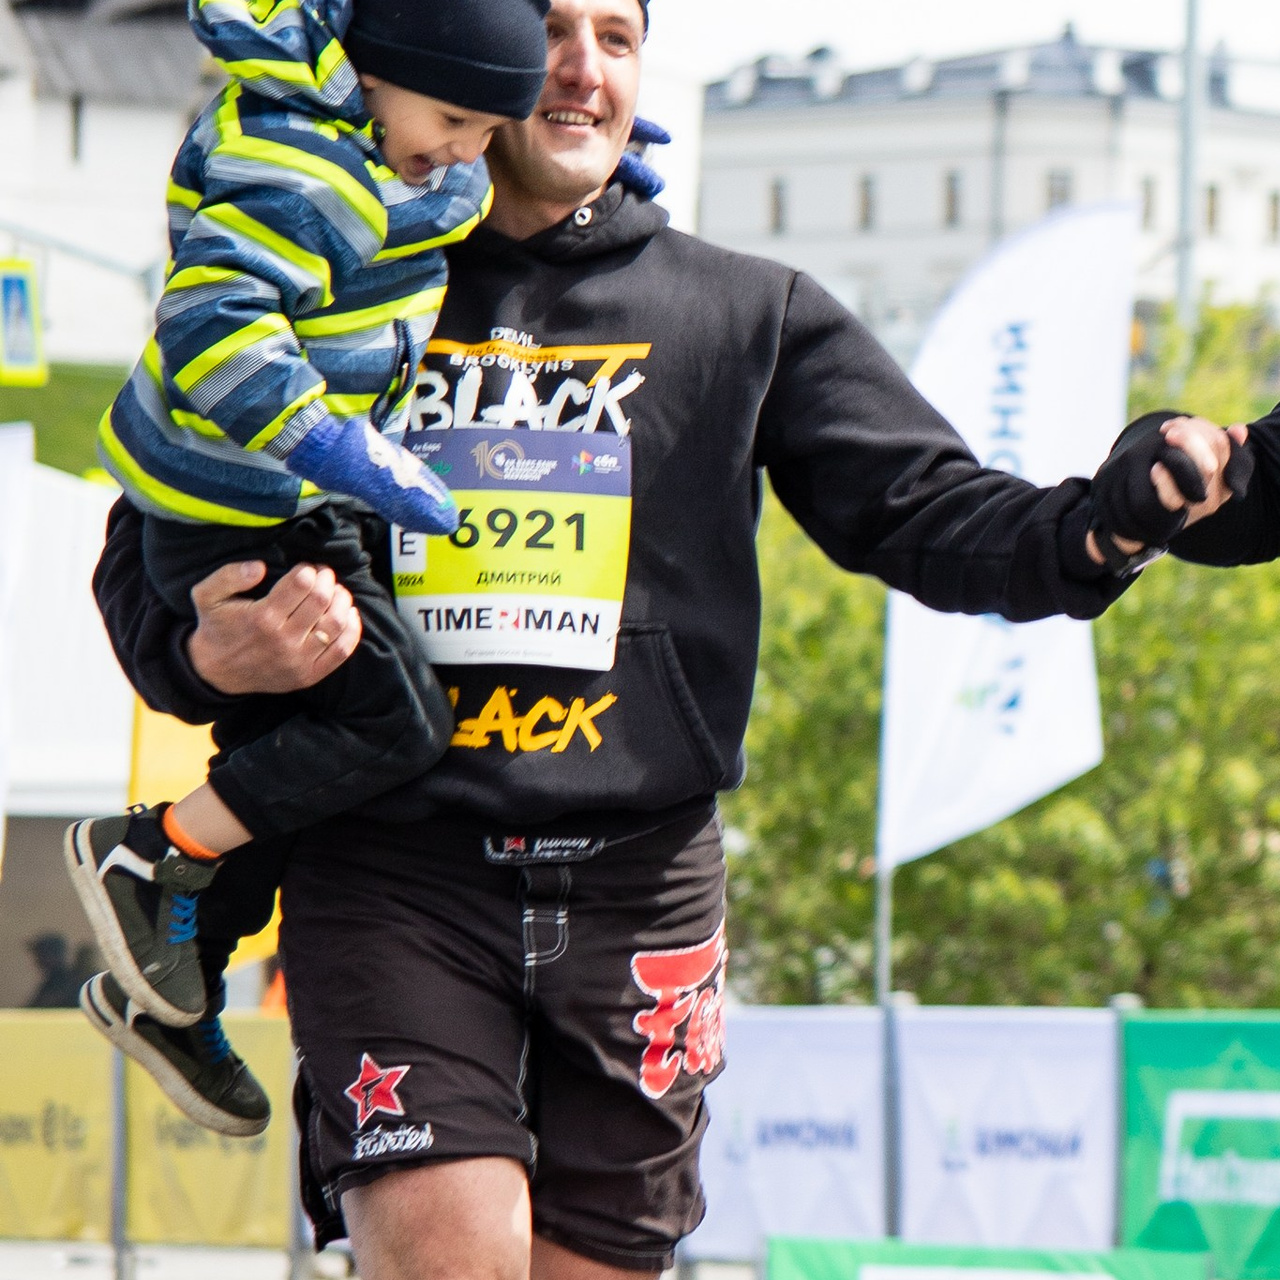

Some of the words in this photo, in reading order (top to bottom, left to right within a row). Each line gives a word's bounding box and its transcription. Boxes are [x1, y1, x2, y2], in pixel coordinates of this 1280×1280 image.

[409, 365, 646, 437] BLACK
[449, 507, 586, 552] 6921
[475, 569, 562, 587] ДМИТРИЙ
[447, 684, 618, 754] LACK
